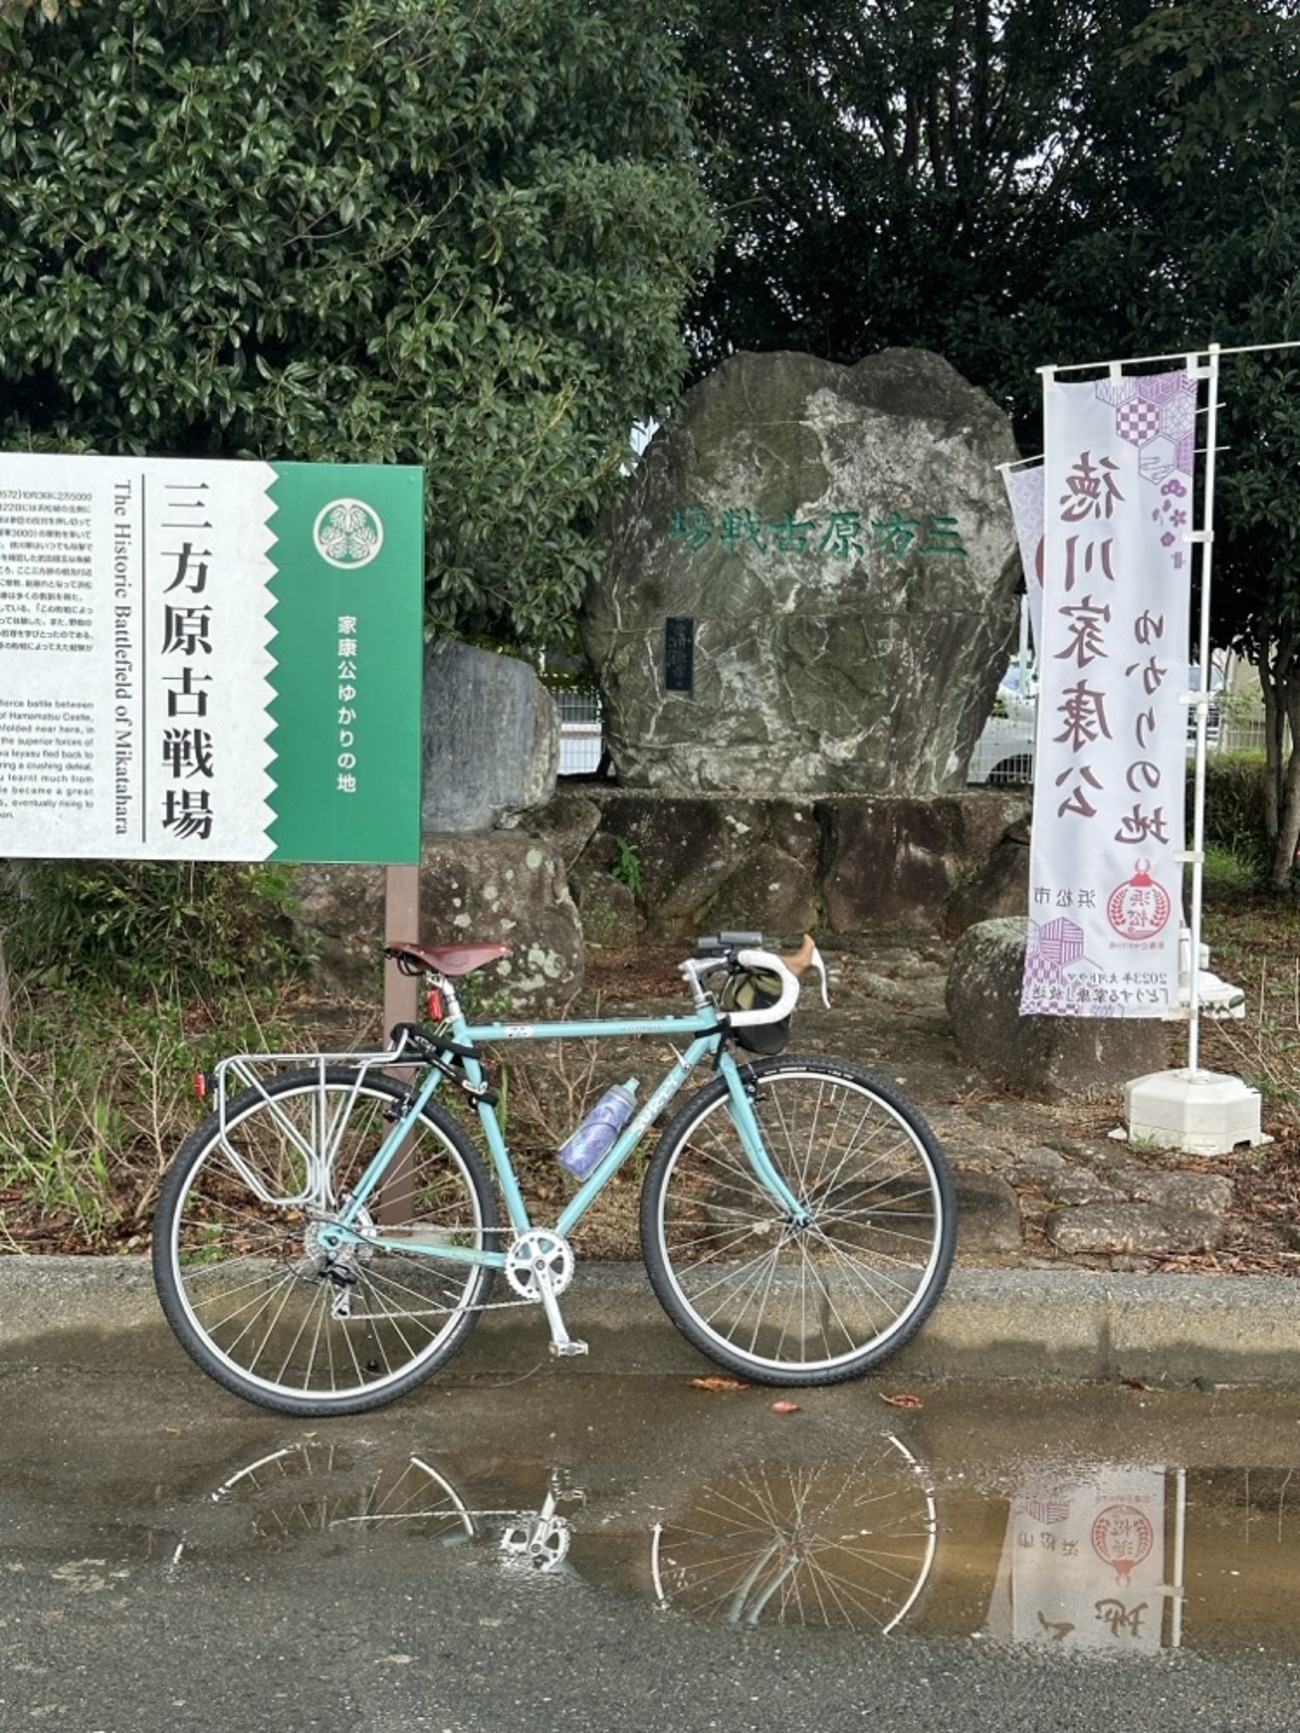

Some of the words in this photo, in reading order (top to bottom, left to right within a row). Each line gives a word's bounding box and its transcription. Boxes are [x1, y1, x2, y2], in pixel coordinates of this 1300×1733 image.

[114, 479, 132, 516] The
[114, 523, 132, 599] Historic
[114, 605, 132, 699] Battlefield
[161, 482, 214, 840] 三方原古戦場
[114, 705, 132, 727] of
[337, 615, 357, 793] 家康公ゆかりの地
[115, 731, 133, 835] Mikatahara
